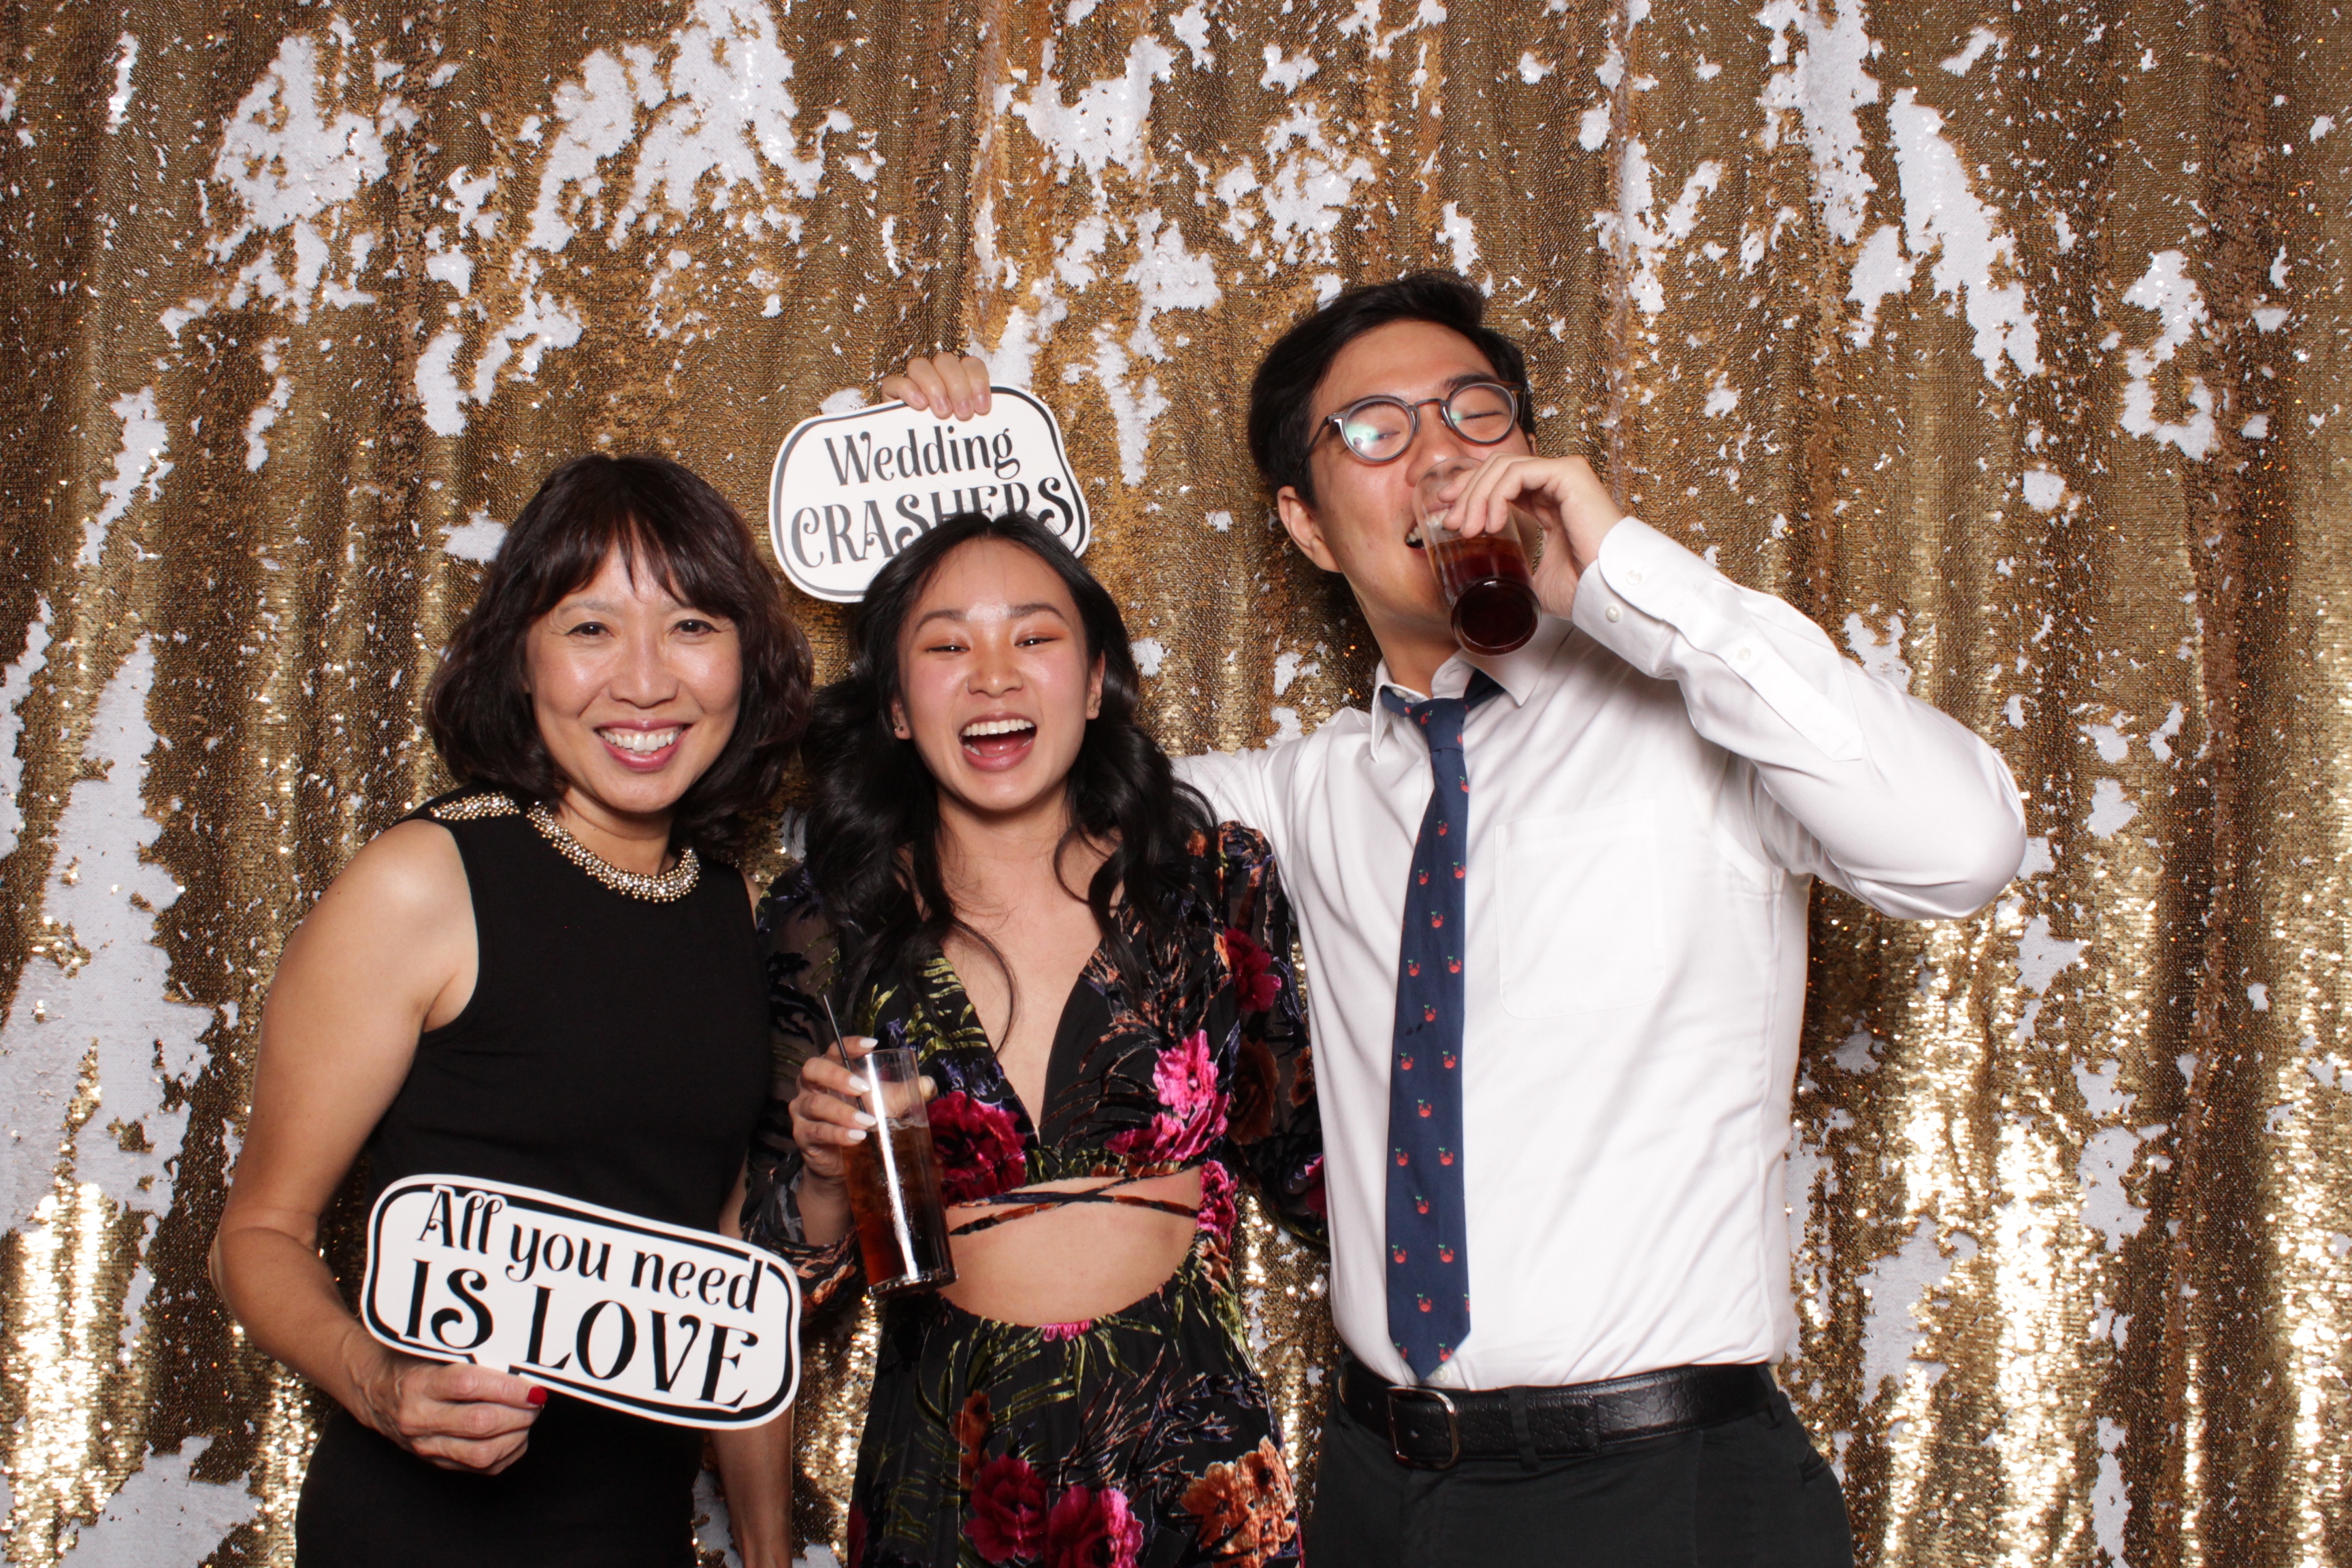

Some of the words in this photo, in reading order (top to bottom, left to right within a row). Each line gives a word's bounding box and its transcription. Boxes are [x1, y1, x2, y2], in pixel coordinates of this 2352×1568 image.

[823, 425, 1021, 485] Wedding
[416, 1190, 504, 1254] All
[505, 1224, 612, 1282] you
[630, 1250, 764, 1313] need
[403, 1258, 494, 1349] IS
[523, 1284, 759, 1408] LOVE
